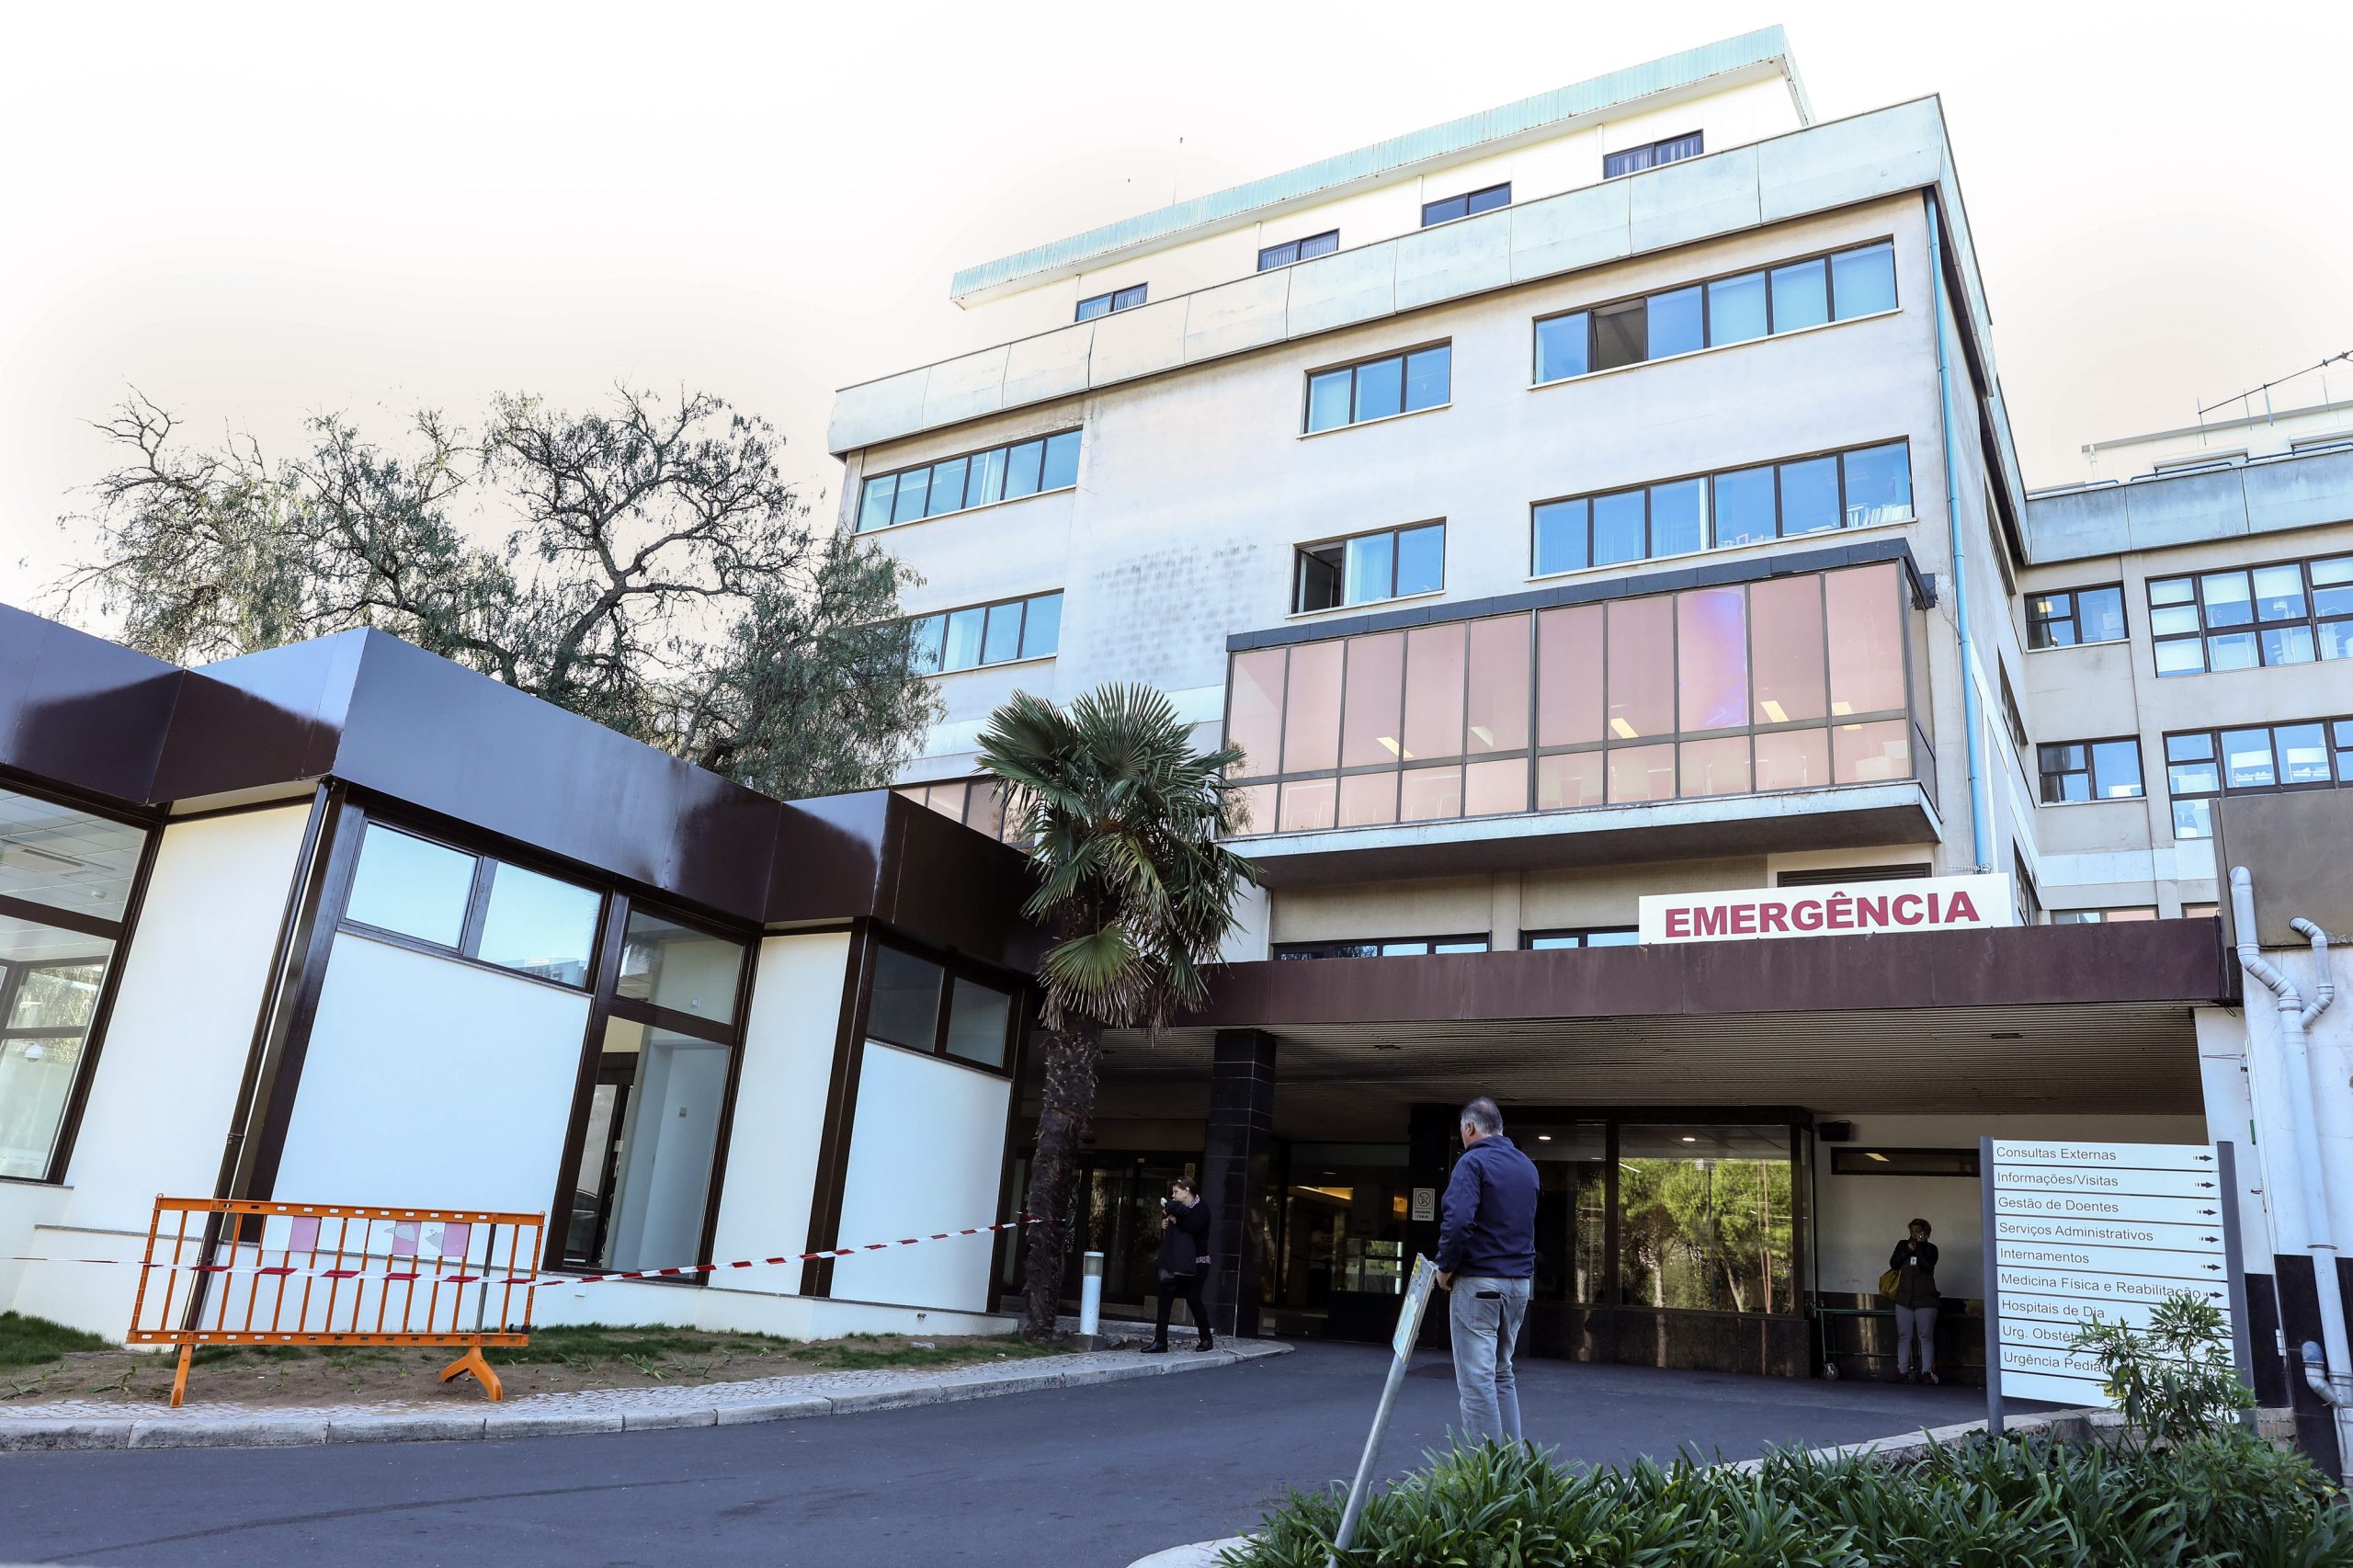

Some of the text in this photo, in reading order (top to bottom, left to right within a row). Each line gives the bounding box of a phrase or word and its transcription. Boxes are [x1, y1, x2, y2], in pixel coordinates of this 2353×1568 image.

[1665, 891, 1981, 937] EMERGÊNCIA
[1996, 1146, 2117, 1161] Consultas Externas
[1997, 1172, 2119, 1187] Informações/Visitas
[1998, 1197, 2119, 1212] Gestão de Doentes
[1999, 1221, 2154, 1242] Serviços Administrativos
[2000, 1247, 2089, 1264] Internamentos
[2001, 1273, 2057, 1288] Medicina
[2062, 1278, 2099, 1291] Física
[2104, 1282, 2112, 1292] e
[2002, 1299, 2105, 1318] Hospitais de Dia
[2003, 1325, 2029, 1340] Urg.
[2004, 1351, 2060, 1368] Urgência
